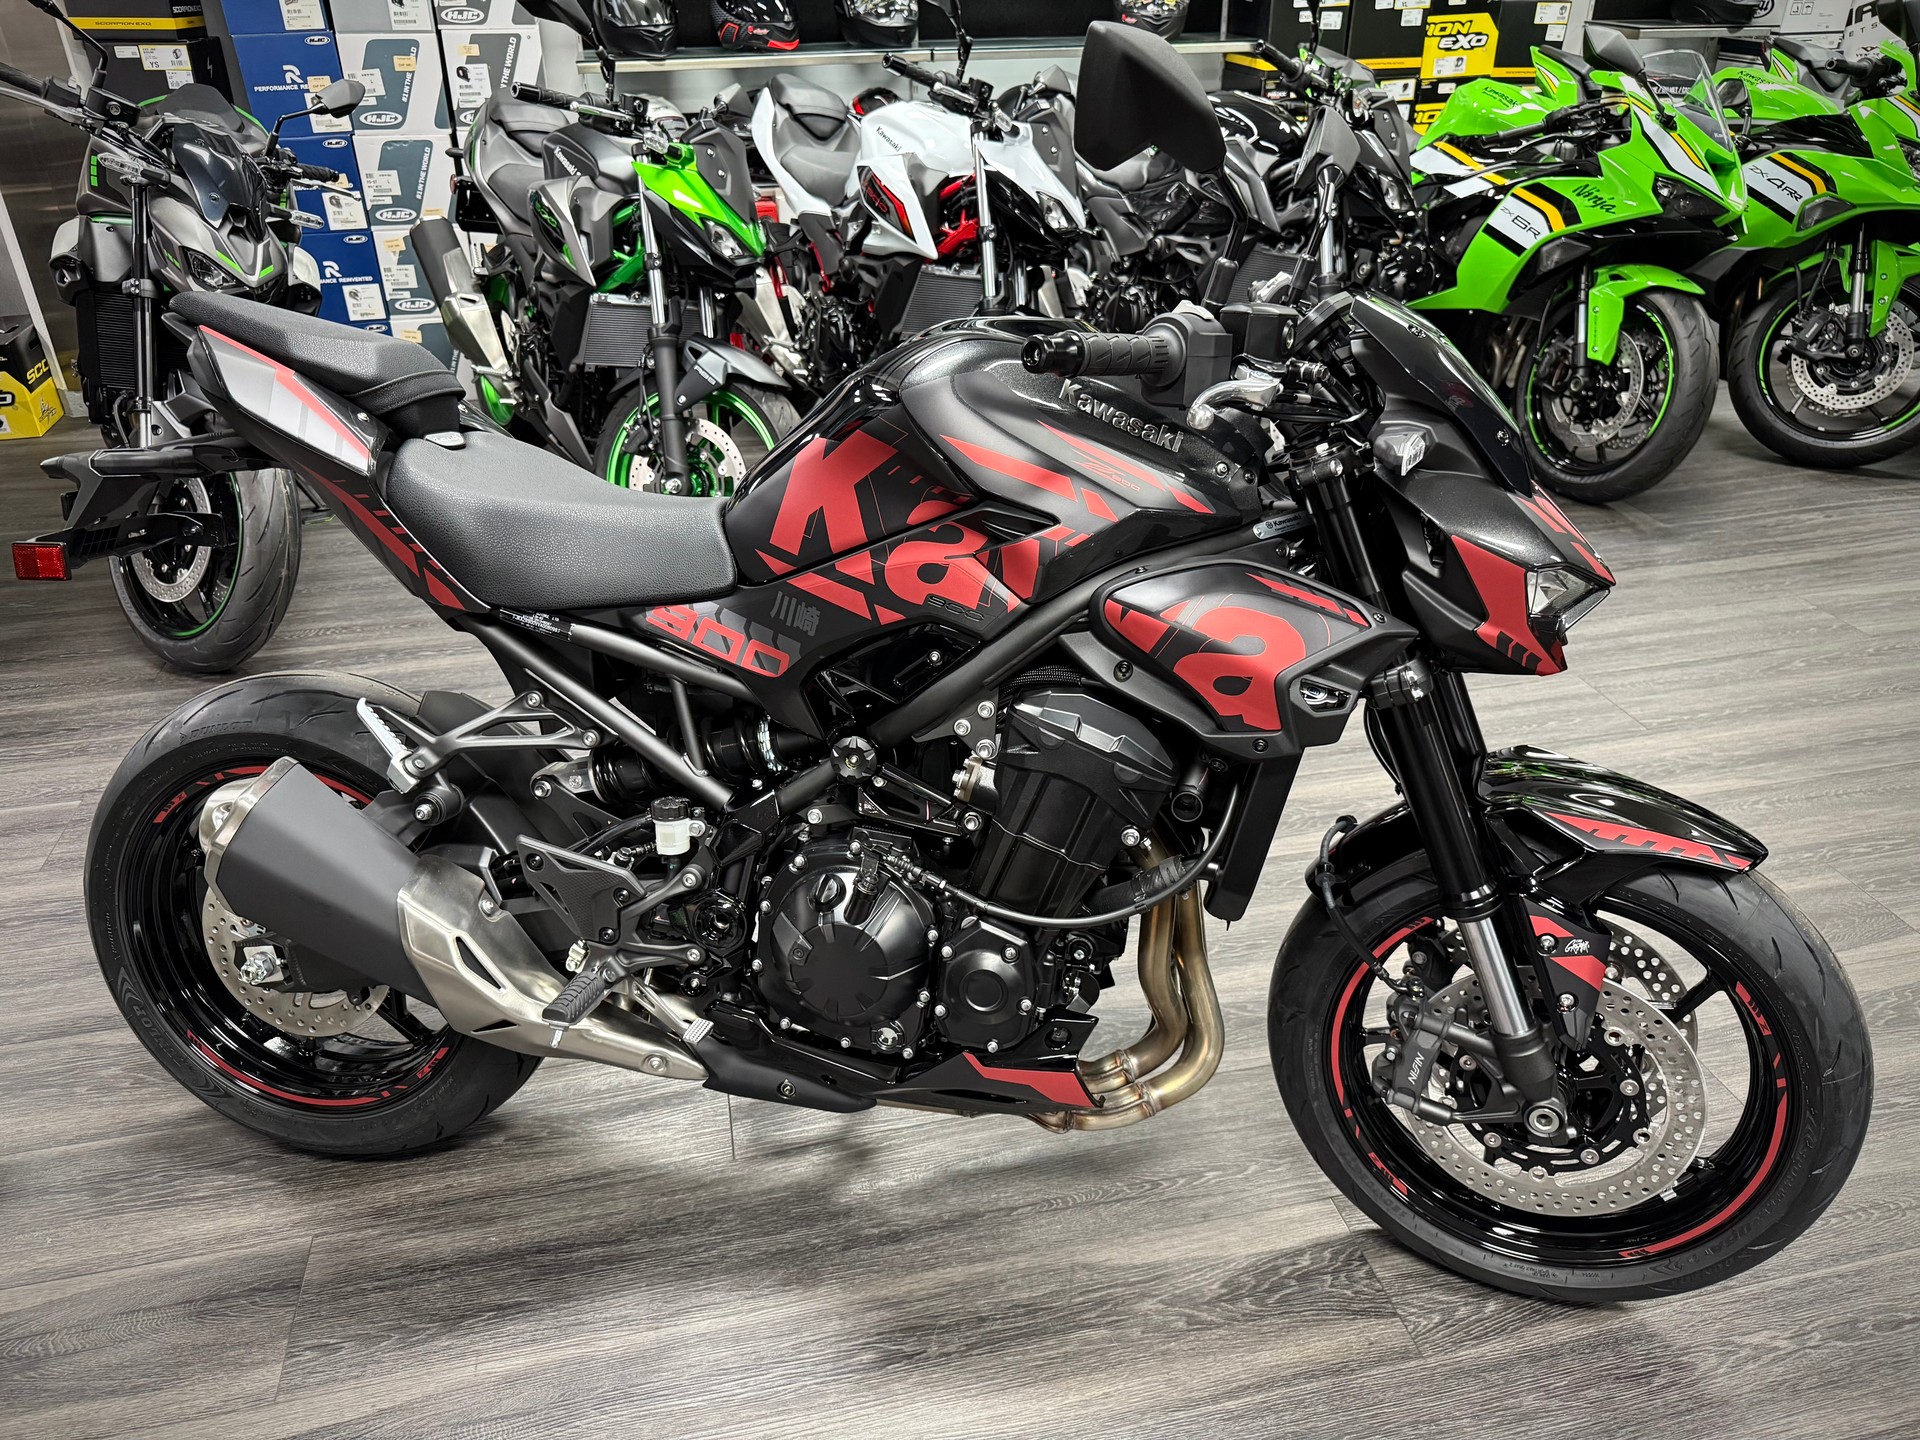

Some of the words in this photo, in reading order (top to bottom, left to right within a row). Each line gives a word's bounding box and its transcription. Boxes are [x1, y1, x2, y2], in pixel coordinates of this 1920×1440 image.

[447, 11, 478, 19] HJC
[504, 36, 516, 67] WORLD
[254, 84, 298, 92] PERFORMANCE
[404, 71, 412, 85] THE
[500, 67, 510, 84] THE
[876, 126, 902, 152] Kawasaki
[421, 146, 430, 171] WORLD
[554, 147, 577, 175] Kawasaki
[418, 170, 426, 183] THE
[1572, 184, 1617, 214] Ninja
[1059, 378, 1184, 453] Kawasaki
[1273, 513, 1301, 527] Kawasaki
[770, 591, 821, 636] 川崎
[646, 604, 790, 678] 900
[191, 720, 253, 739] DUNLOP
[1408, 1051, 1424, 1085] NISSIN
